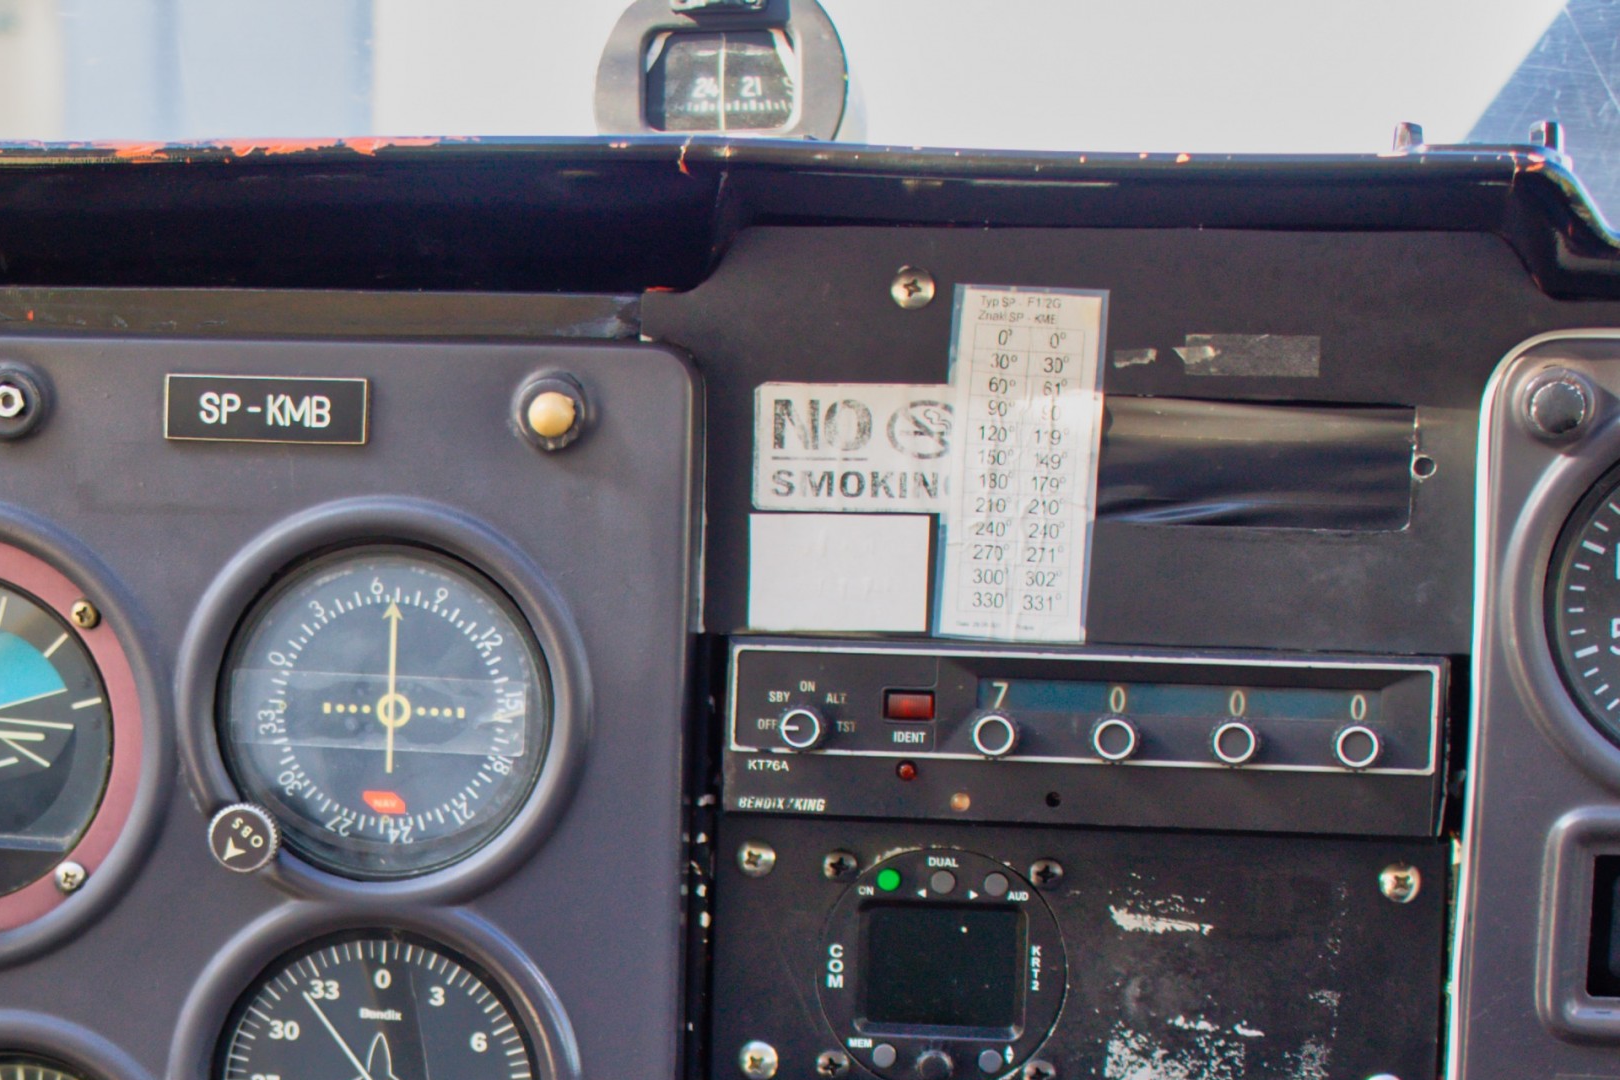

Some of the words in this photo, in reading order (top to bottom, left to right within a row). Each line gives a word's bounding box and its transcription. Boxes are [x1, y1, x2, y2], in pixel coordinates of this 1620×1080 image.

[692, 77, 719, 98] 24
[741, 76, 762, 97] 21
[773, 399, 873, 450] NO
[371, 578, 383, 595] 6
[436, 588, 449, 605] 9
[309, 600, 325, 619] 3
[481, 626, 503, 651] 12
[800, 681, 815, 692] ON
[768, 691, 790, 703] SBY
[826, 693, 847, 703] ALT
[991, 681, 1009, 710] 7
[1110, 686, 1126, 714] 0
[1230, 690, 1246, 717] 0
[1351, 694, 1367, 721] 0
[258, 709, 277, 735] 33
[758, 719, 777, 730] OFF
[837, 721, 855, 732] TST
[893, 731, 926, 743] IDENT
[748, 760, 789, 771] KT76A
[231, 817, 264, 848] OBS
[928, 857, 959, 868] DUAL
[858, 886, 874, 896] ON
[1008, 891, 1029, 901] AUD
[828, 944, 844, 988] COM
[1031, 946, 1041, 992] KRT2
[375, 969, 391, 989] 0
[310, 980, 339, 1000] 33
[429, 986, 445, 1006] 3
[359, 1007, 402, 1021] Bendix
[269, 1021, 300, 1040] 30
[471, 1033, 487, 1052] 6
[848, 1038, 872, 1049] MEM
